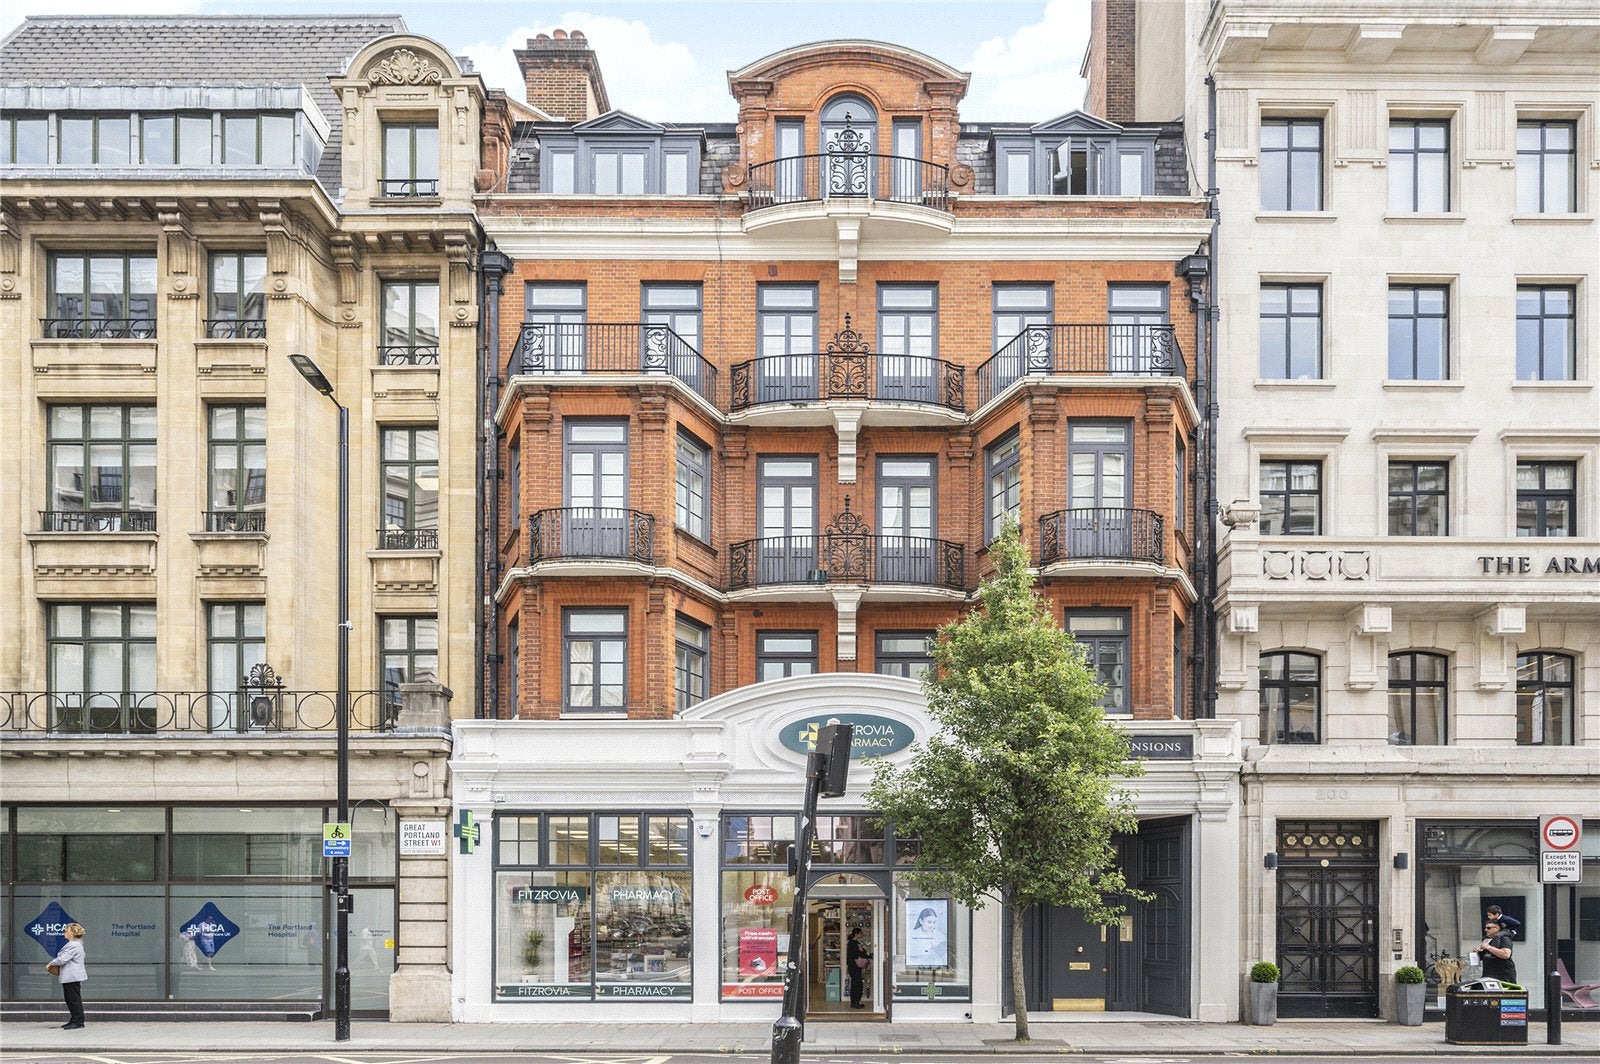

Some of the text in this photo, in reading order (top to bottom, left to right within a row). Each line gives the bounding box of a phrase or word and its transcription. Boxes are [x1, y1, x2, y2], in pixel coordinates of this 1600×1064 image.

[1478, 556, 1531, 574] THE
[852, 725, 894, 735] ROVIA
[850, 738, 894, 747] RMACY
[1126, 742, 1181, 752] NSIONS
[518, 890, 579, 900] FITZROVIA
[613, 890, 675, 900] PHARMACY
[202, 924, 225, 932] HCA
[518, 987, 570, 995] FITZROVIA
[612, 987, 675, 995] PHARMACY
